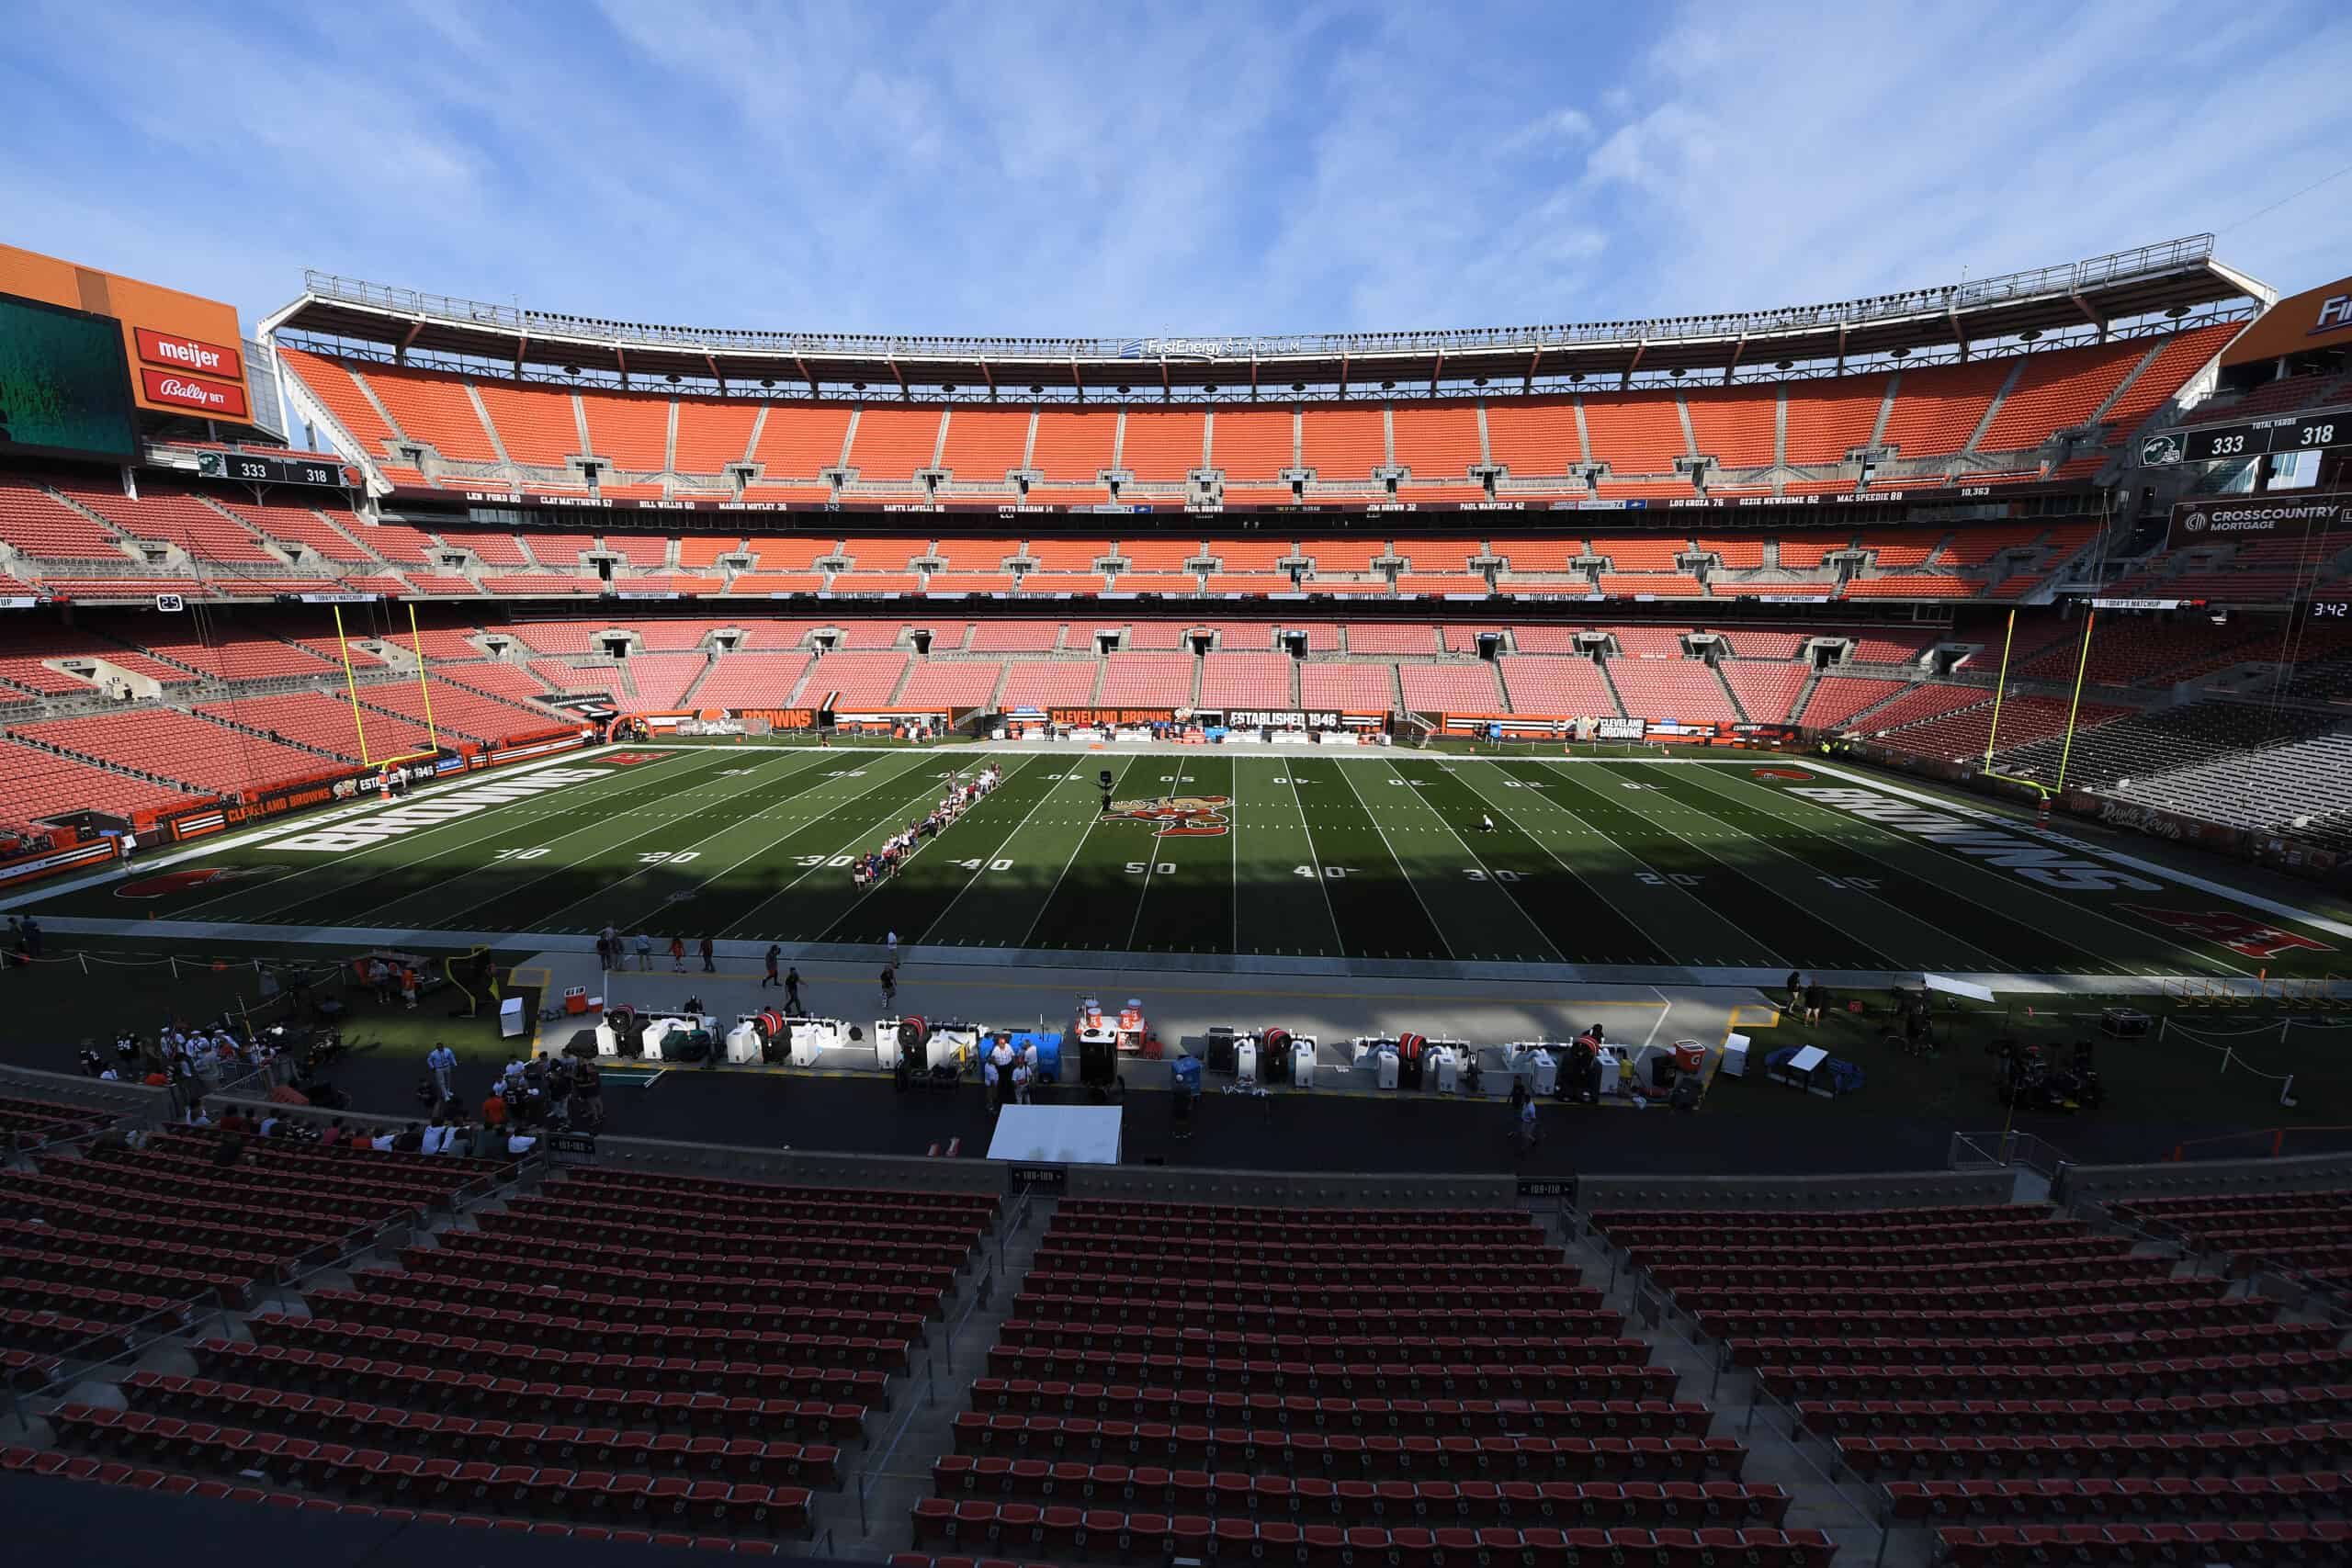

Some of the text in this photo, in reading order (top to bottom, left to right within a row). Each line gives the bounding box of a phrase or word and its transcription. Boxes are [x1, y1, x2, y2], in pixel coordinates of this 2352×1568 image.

[158, 341, 220, 367] meijer
[1148, 340, 1302, 355] FirstEnergy STADIUM
[161, 379, 225, 404] Bally BET
[2301, 424, 2335, 445] 318
[2211, 435, 2244, 455] 333
[241, 463, 266, 478] 333
[307, 468, 327, 483] 318
[1838, 494, 1853, 502] MAC
[1856, 492, 1889, 502] SPEEDIE
[2211, 505, 2340, 523] CROSSCOUNTRY
[2211, 521, 2275, 532] MORTGAGE
[161, 597, 178, 609] 25
[2314, 603, 2347, 616] 3:42
[1053, 710, 1171, 724] CLEVELAND BROWNS
[1230, 711, 1337, 727] ESTABLISHED 1946
[1600, 719, 1644, 728] CLEVELAND
[1600, 728, 1643, 737] BROWNS
[289, 787, 331, 807] BROWNS
[256, 768, 618, 852] BROWNS
[1782, 787, 2165, 890] BROWNS
[497, 848, 551, 860] 10
[641, 852, 701, 863] 20
[797, 854, 855, 867] 30
[961, 858, 1013, 871] 40
[1124, 862, 1177, 875] 50
[1293, 865, 1346, 878] 40
[1464, 868, 1523, 883] 30
[1634, 872, 1698, 886] 20
